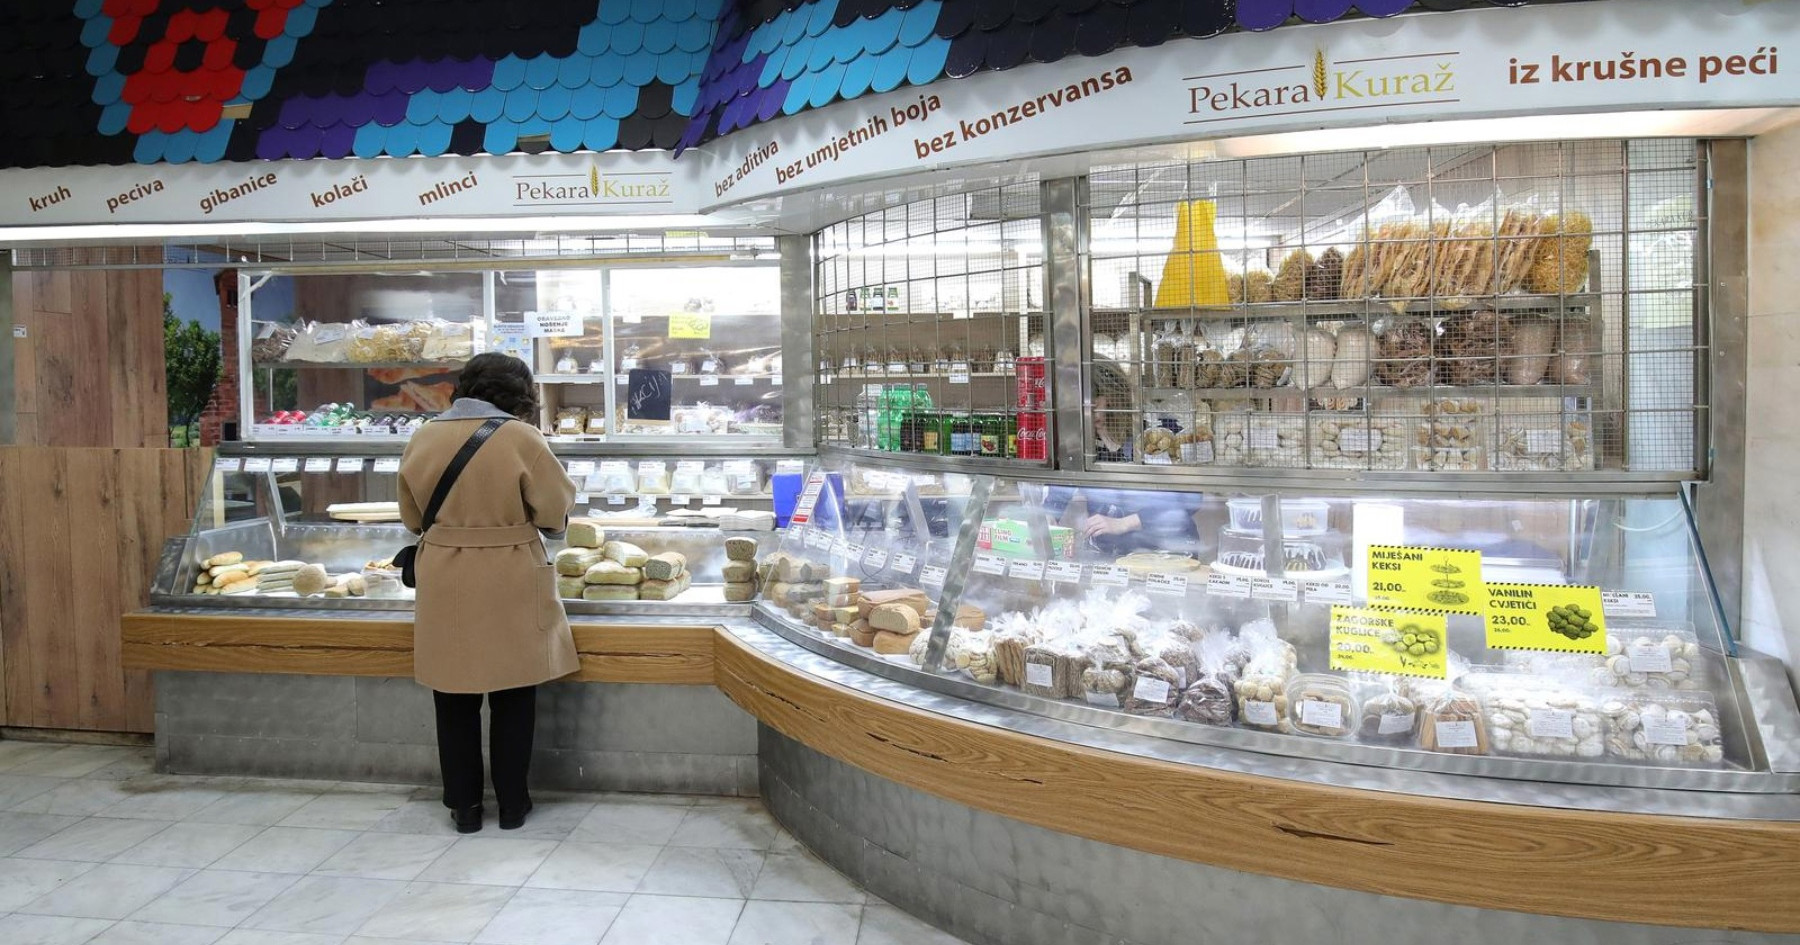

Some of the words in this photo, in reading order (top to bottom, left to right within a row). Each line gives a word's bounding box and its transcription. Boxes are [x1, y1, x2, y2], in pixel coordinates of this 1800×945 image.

[1508, 58, 1540, 84] iz
[1552, 49, 1688, 83] krušne
[1698, 44, 1780, 84] peći
[1188, 82, 1310, 115] Pekara
[1332, 61, 1456, 101] Kuraž
[914, 130, 957, 160] bez
[960, 64, 1133, 141] konzervansa
[775, 162, 804, 185] bez
[805, 116, 888, 168] umjetnih
[892, 91, 942, 129] boja
[713, 175, 735, 198] bez
[735, 139, 779, 178] aditiva
[28, 185, 72, 213] kruh
[106, 178, 165, 213] peciva
[199, 171, 279, 215] gibanice
[310, 174, 369, 208] kolači
[418, 170, 479, 206] mlinci
[515, 181, 589, 200] Pekara
[603, 177, 670, 198] Kuraž
[1371, 550, 1423, 561] MIJEŠANI
[1371, 562, 1401, 571] KEKSI
[1488, 588, 1533, 598] VANILIN
[1336, 614, 1395, 627] ZAGORSKE
[1336, 626, 1381, 638] KUGLICE
